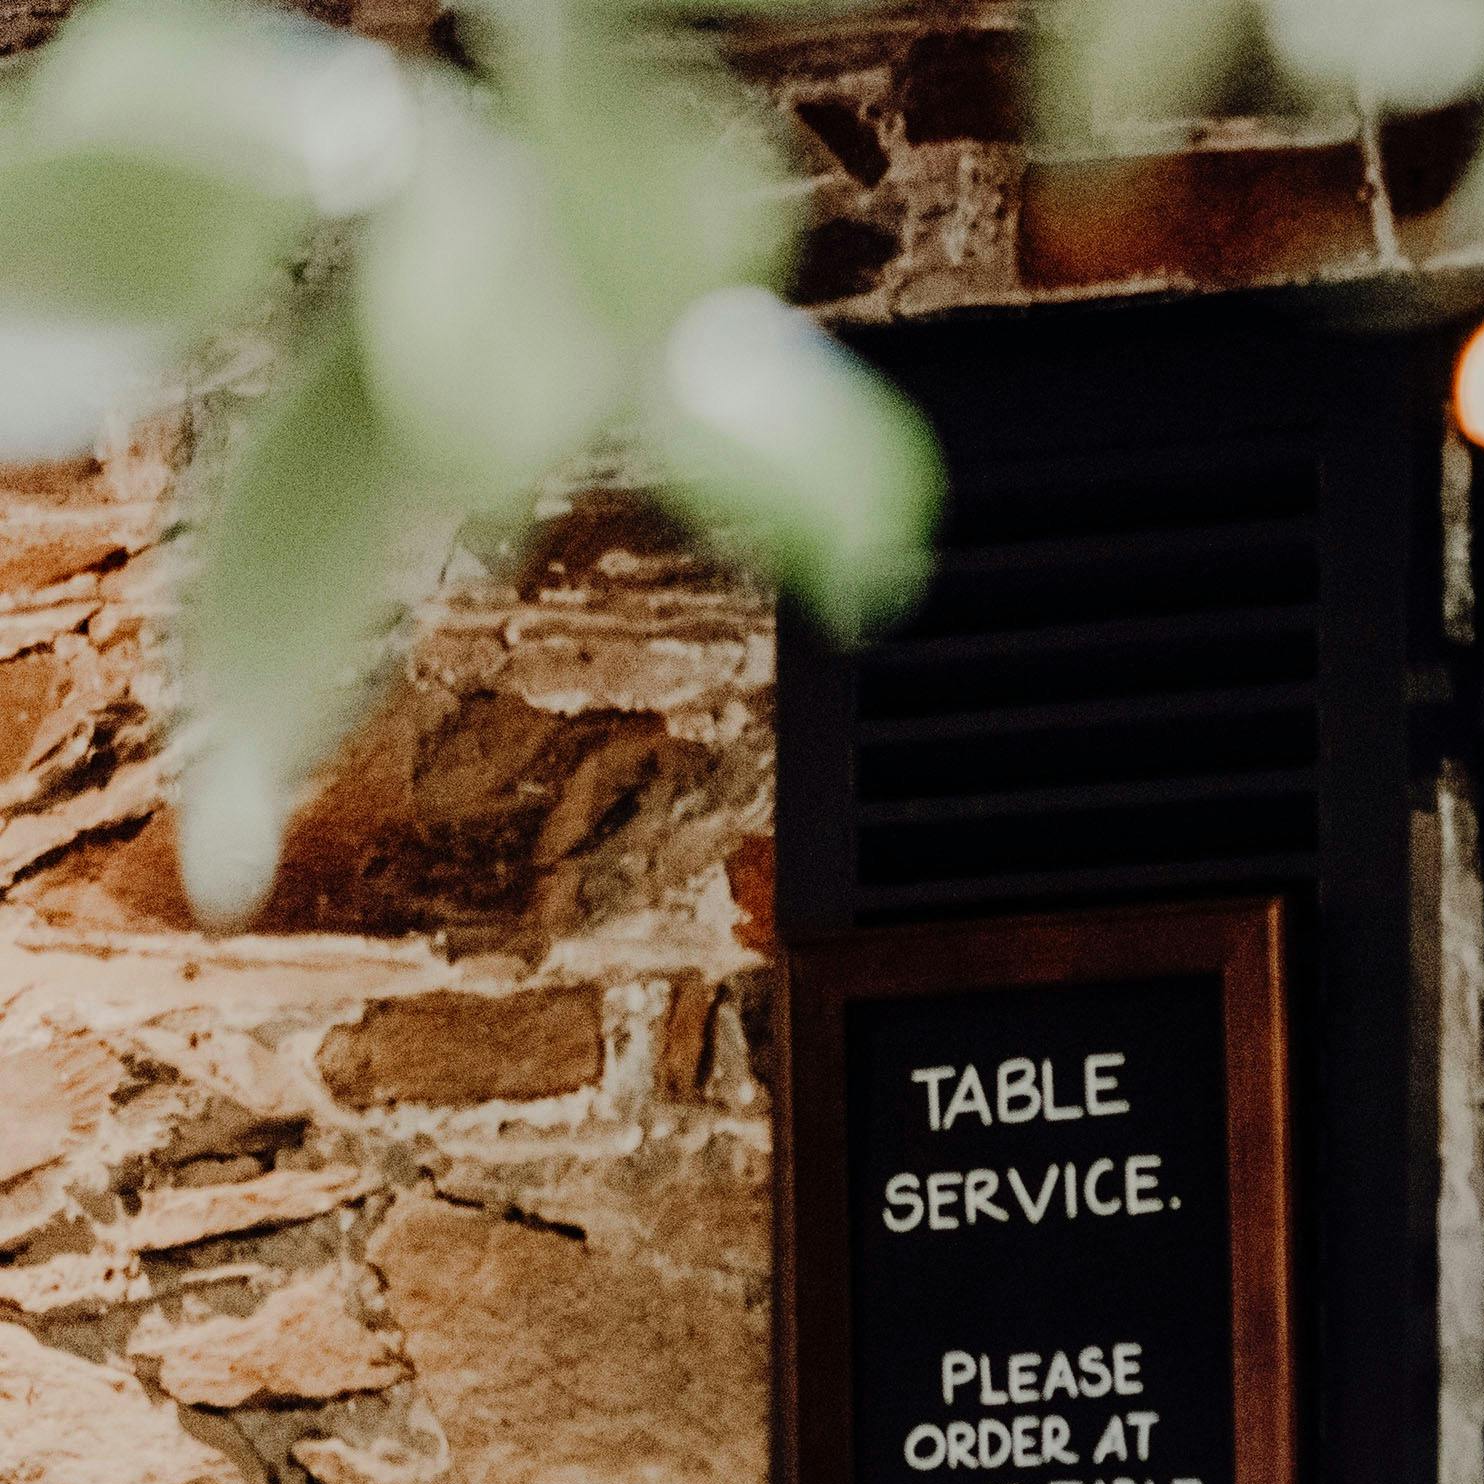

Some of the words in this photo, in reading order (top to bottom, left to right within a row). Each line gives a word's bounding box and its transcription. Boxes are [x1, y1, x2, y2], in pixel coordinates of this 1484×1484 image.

[910, 1053, 1130, 1131] TABLE
[882, 1154, 1182, 1234] SERVICE.
[940, 1342, 1144, 1406] PLEASE
[902, 1414, 1080, 1471] ORDER
[1092, 1410, 1160, 1464] AT
